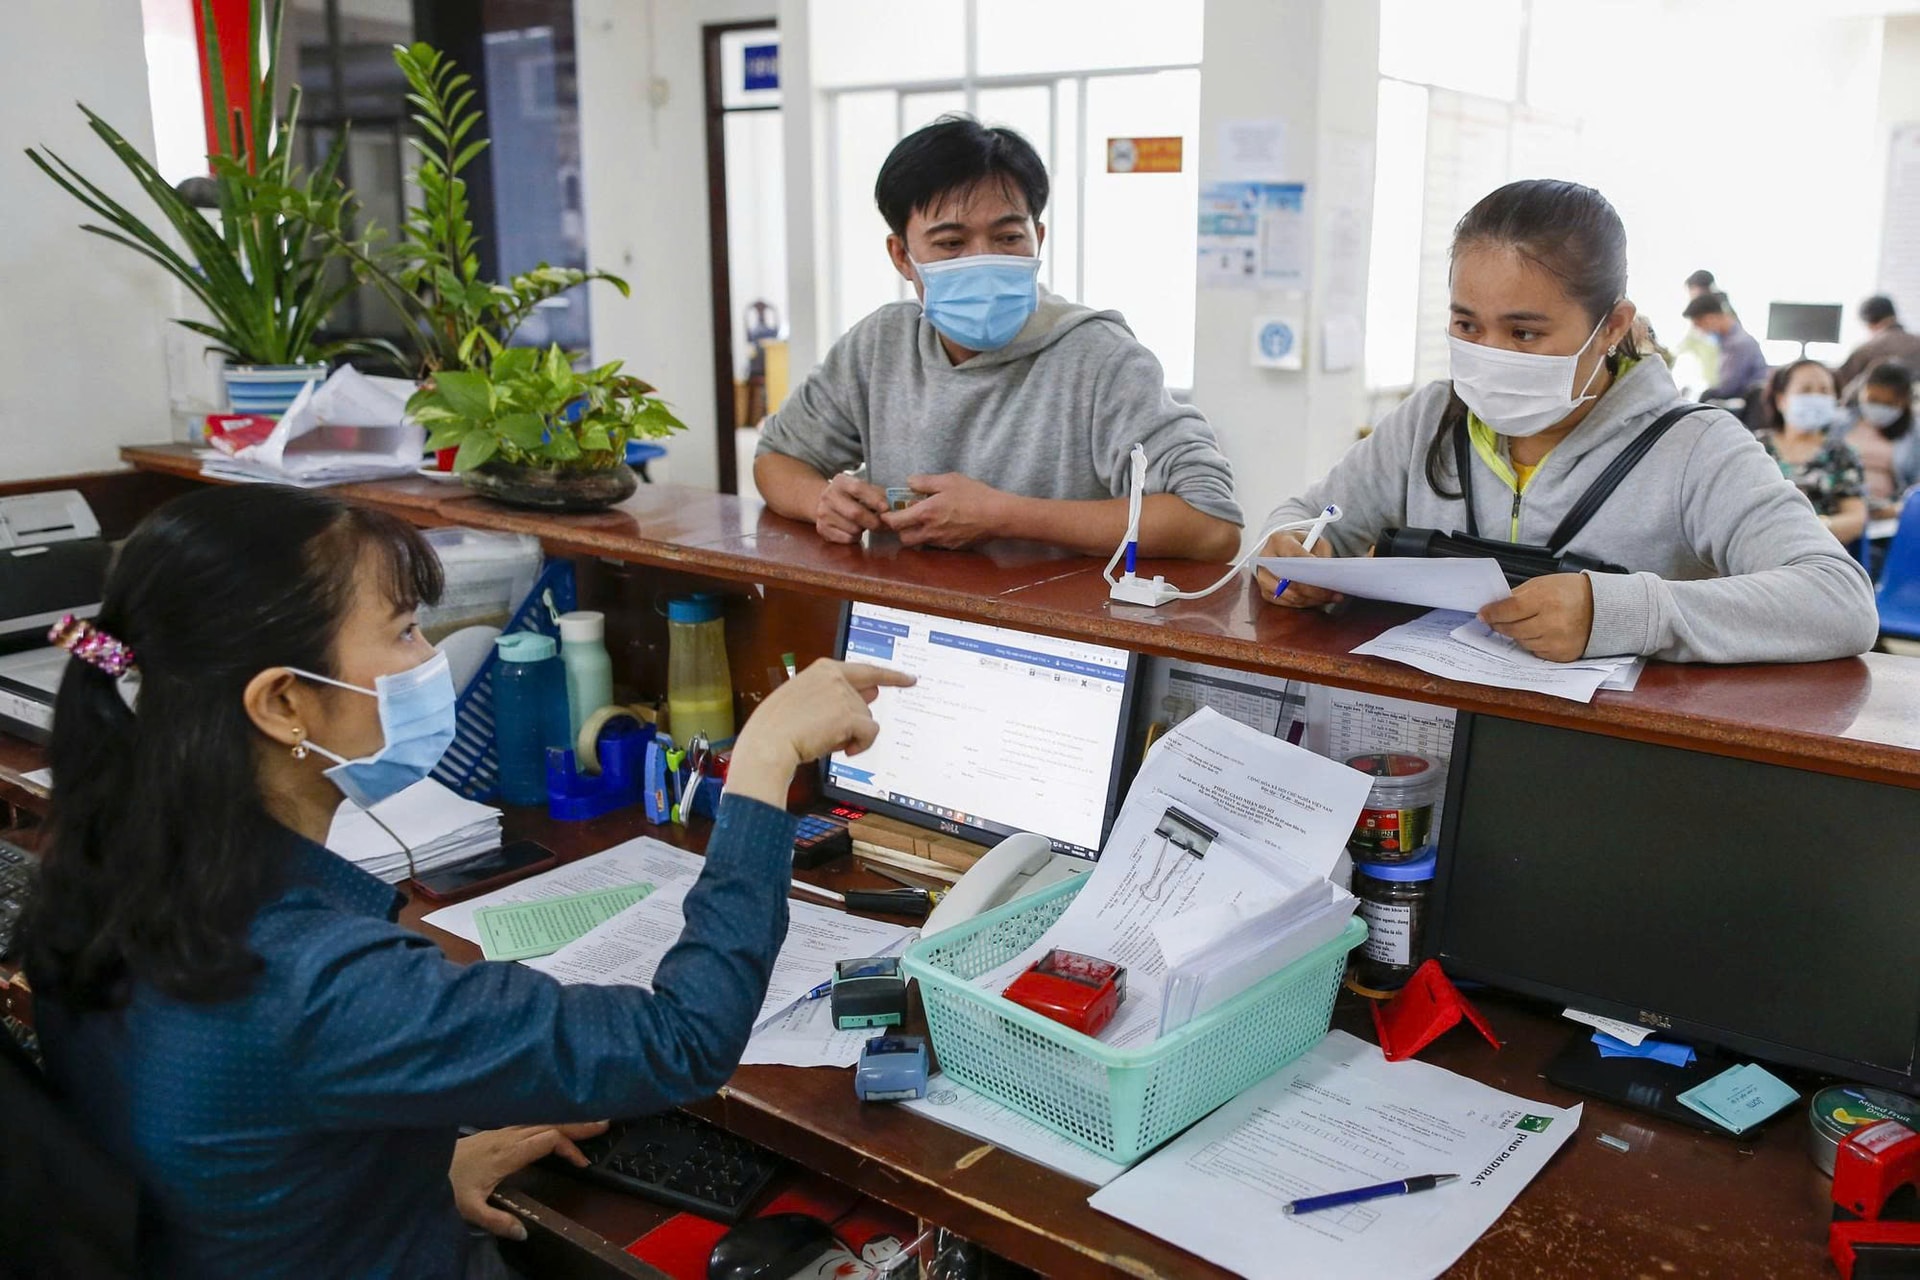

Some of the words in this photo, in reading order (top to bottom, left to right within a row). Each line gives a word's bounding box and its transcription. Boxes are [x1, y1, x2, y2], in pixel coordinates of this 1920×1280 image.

[1639, 1010, 1672, 1029] DELL
[1858, 1100, 1888, 1113] Mixed
[1887, 1110, 1912, 1122] Fruit
